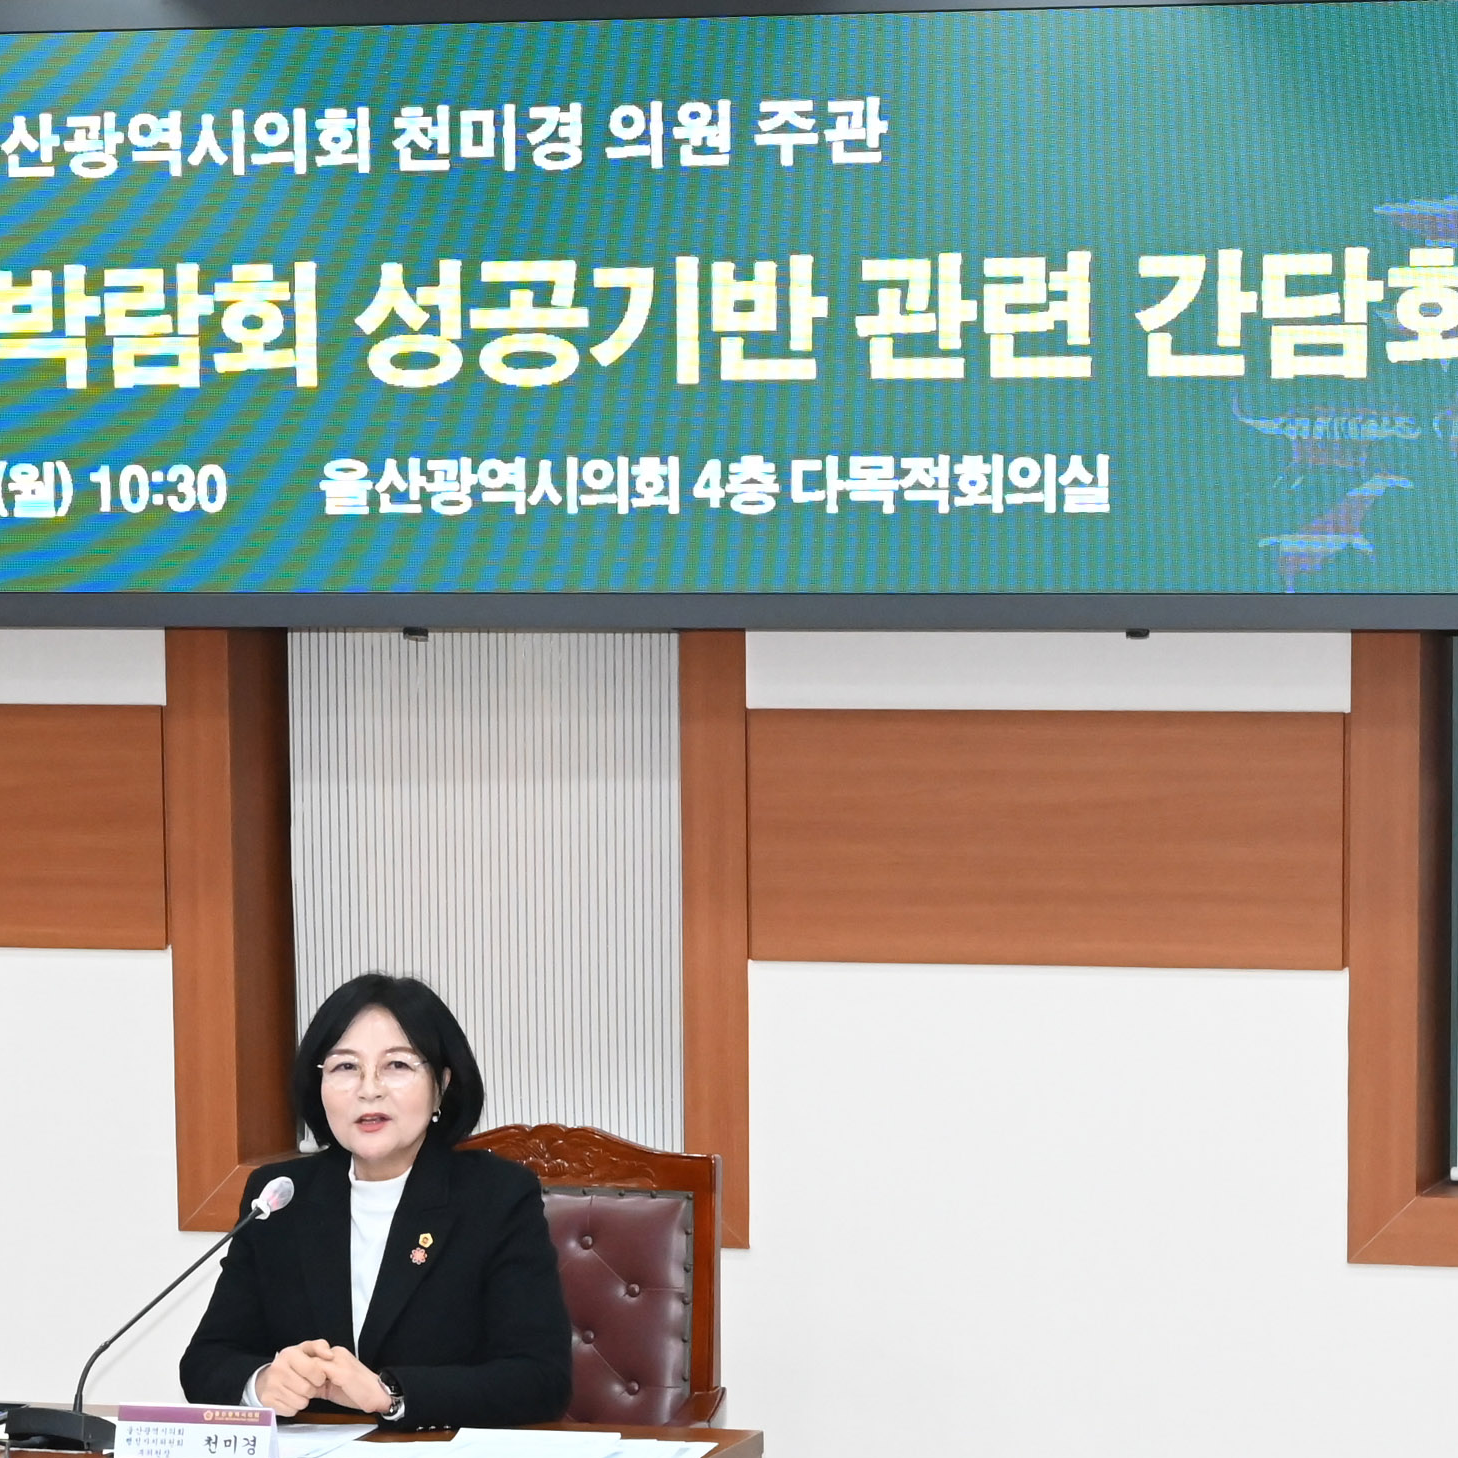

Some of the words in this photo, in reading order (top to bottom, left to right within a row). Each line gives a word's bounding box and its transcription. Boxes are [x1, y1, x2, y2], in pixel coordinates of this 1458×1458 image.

[391, 102, 584, 173] 천미경
[604, 98, 732, 170] 의원
[753, 96, 889, 167] 주관
[353, 254, 830, 388] 성공기반
[854, 250, 1094, 381] 관련
[89, 463, 229, 515] 10:30
[318, 454, 681, 517] 울산광역시의회
[691, 454, 780, 517] 4층
[789, 452, 1112, 516] 다목적회의실
[203, 1434, 257, 1456] 천미경
